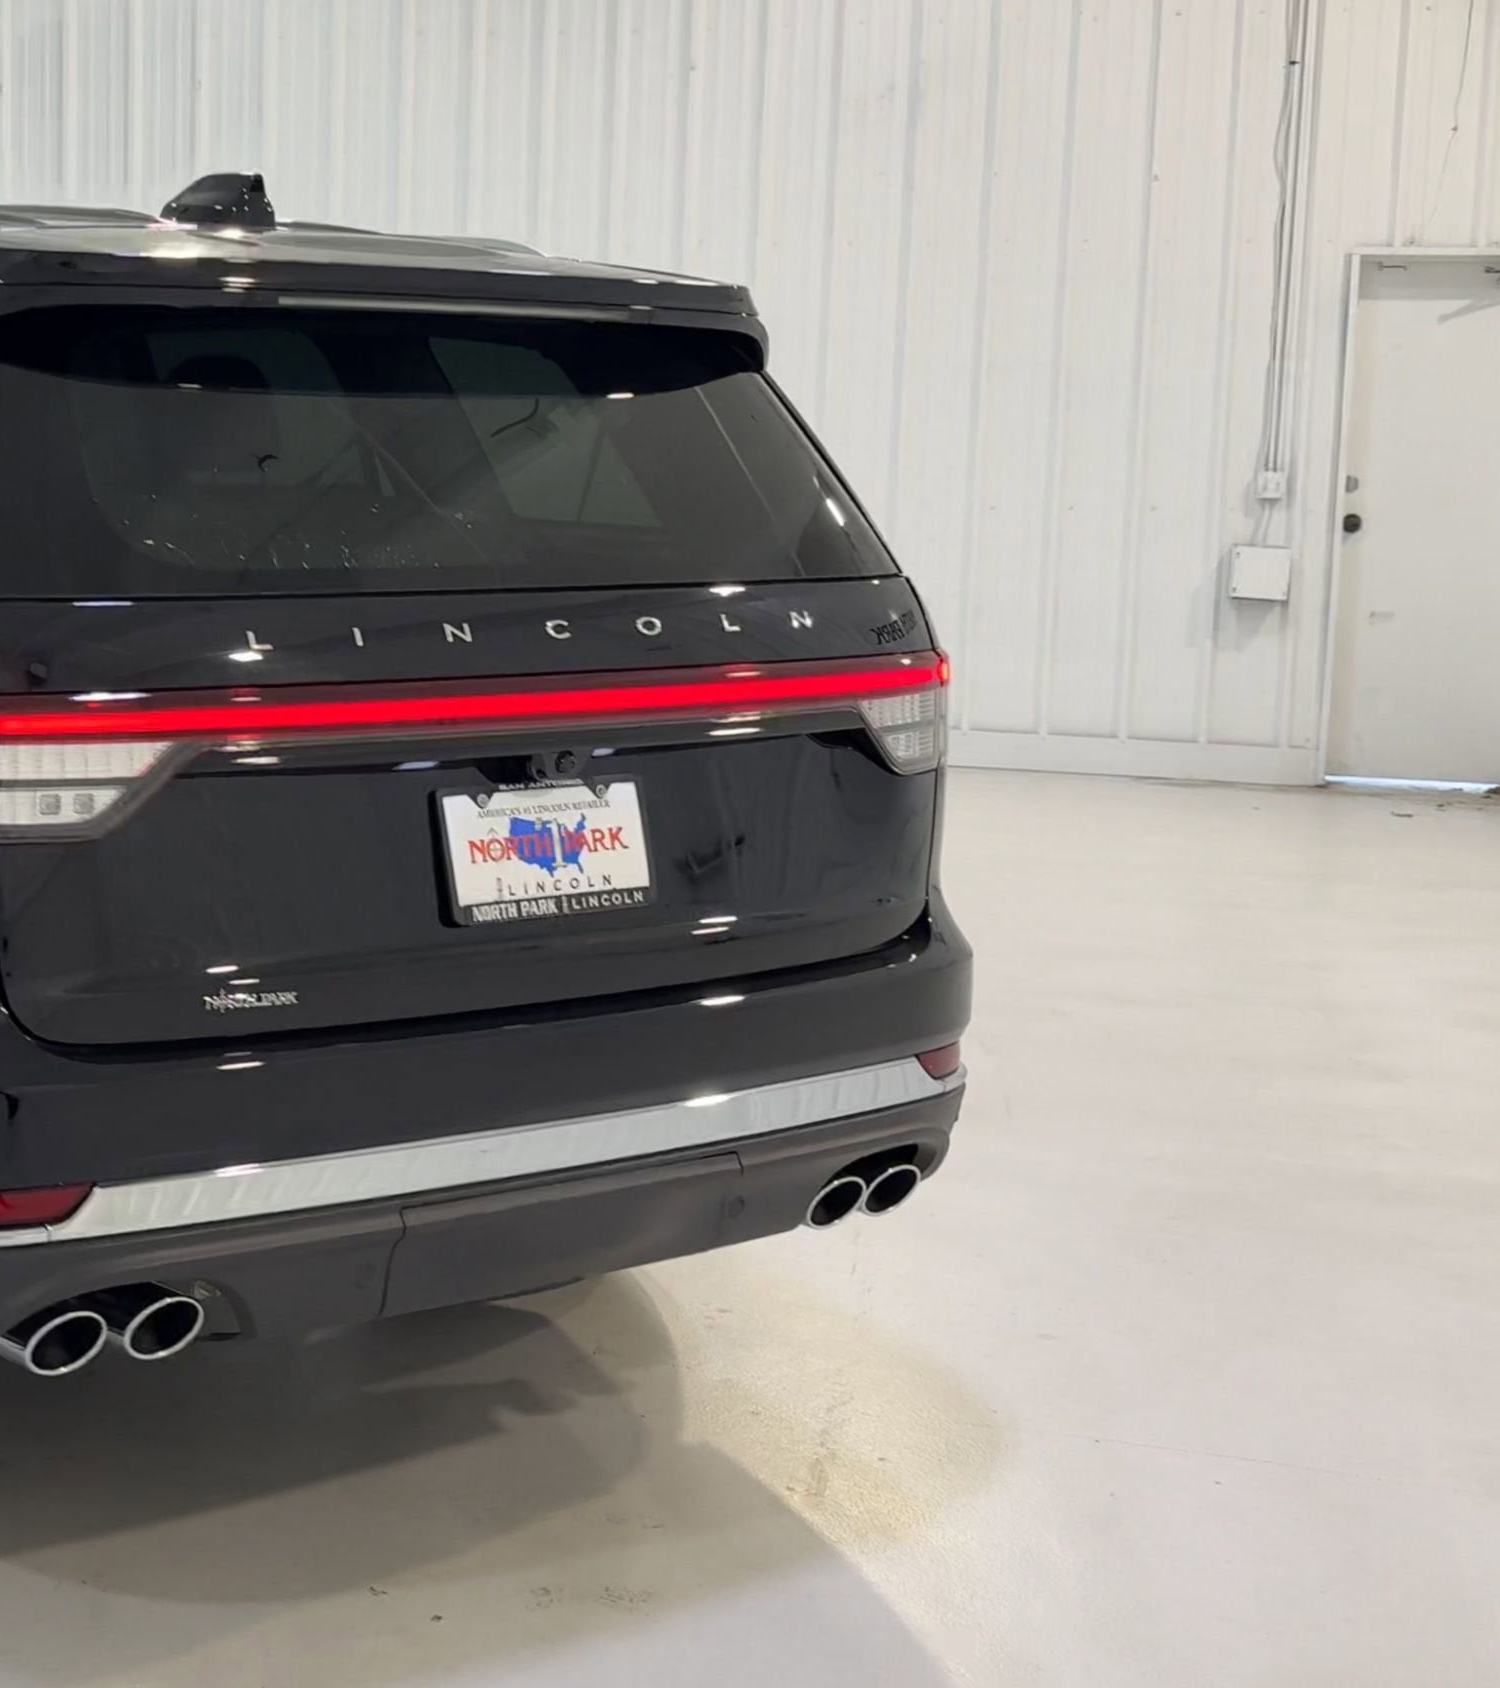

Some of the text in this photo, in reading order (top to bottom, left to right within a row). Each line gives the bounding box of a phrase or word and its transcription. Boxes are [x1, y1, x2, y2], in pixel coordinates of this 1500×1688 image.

[246, 611, 814, 652] LINCOLN
[467, 827, 629, 864] NORTH PARK
[508, 874, 612, 897] LINCOLN
[471, 890, 644, 922] NORTH PARK LINCOLN
